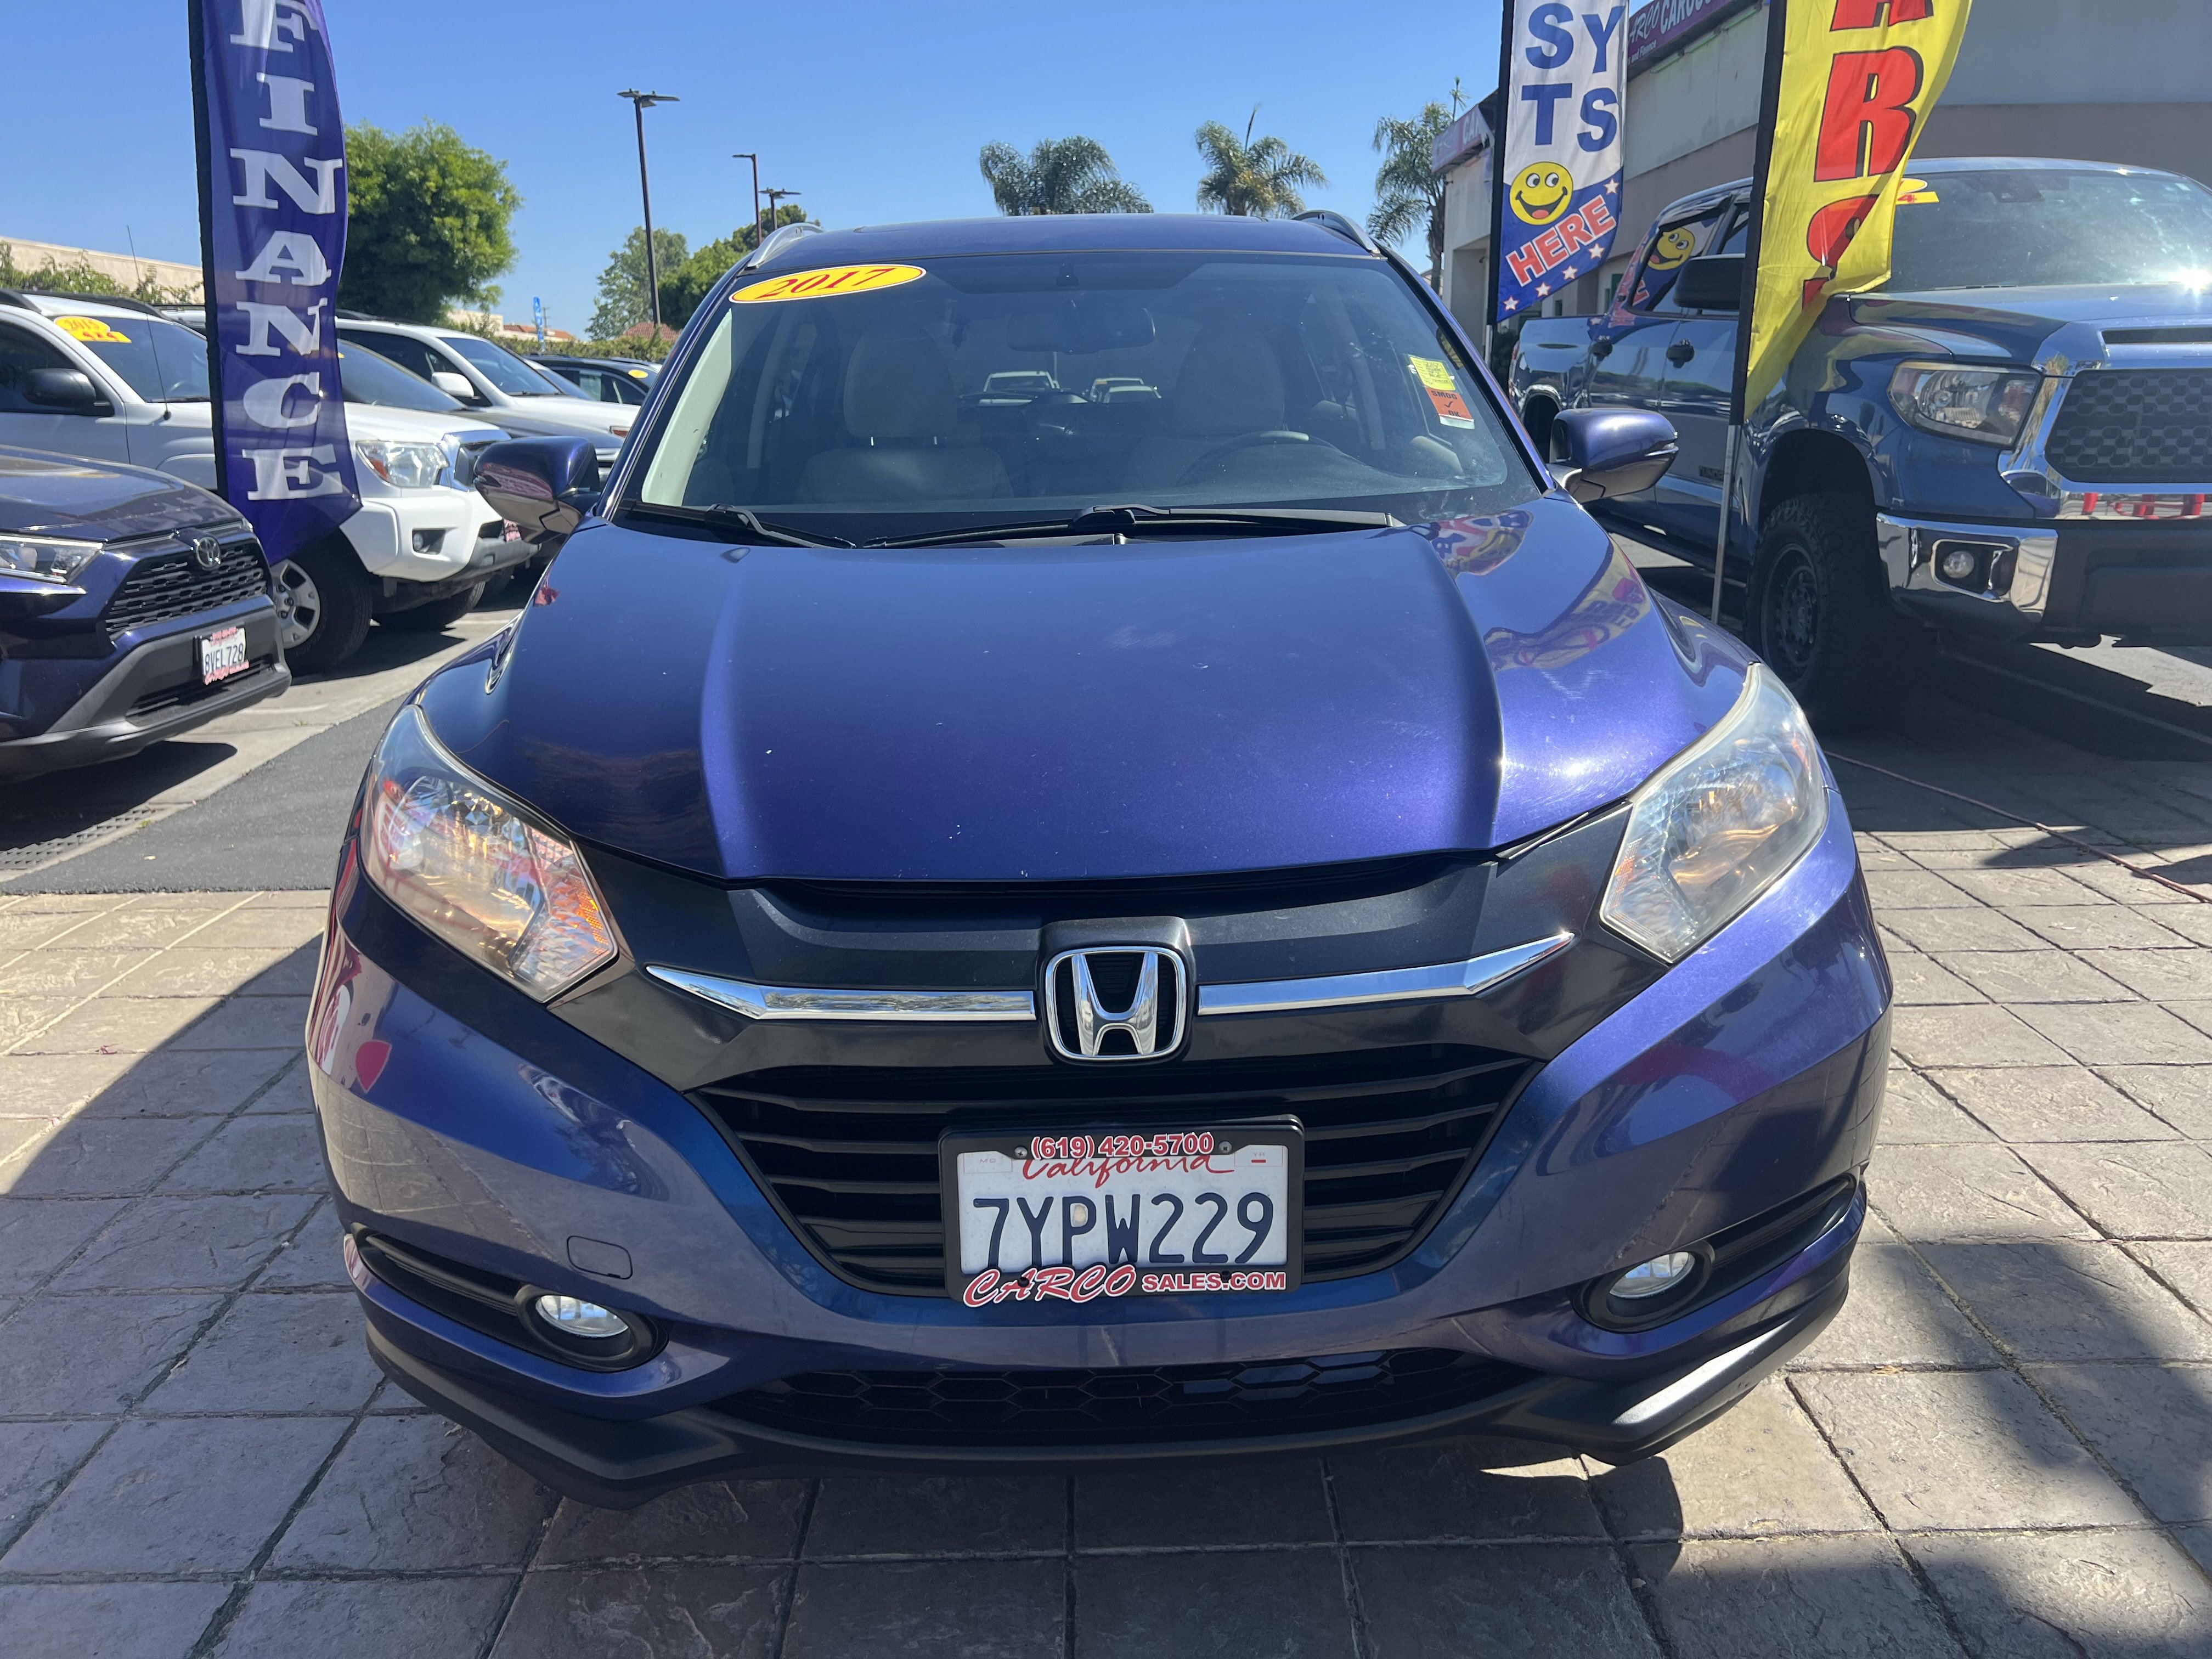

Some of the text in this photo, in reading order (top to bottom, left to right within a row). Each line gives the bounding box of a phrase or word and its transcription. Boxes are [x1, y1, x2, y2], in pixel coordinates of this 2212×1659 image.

[230, 0, 343, 501] FINANCE
[1505, 194, 1616, 287] HERE
[755, 268, 898, 300] 2017
[1431, 390, 1458, 400] SMOG
[205, 642, 244, 673] 8VEL728
[1031, 1132, 1214, 1160] (619) 420-5700
[973, 1191, 1274, 1268] 7YPW229
[963, 1263, 1286, 1308] CARCO SALES.COM
